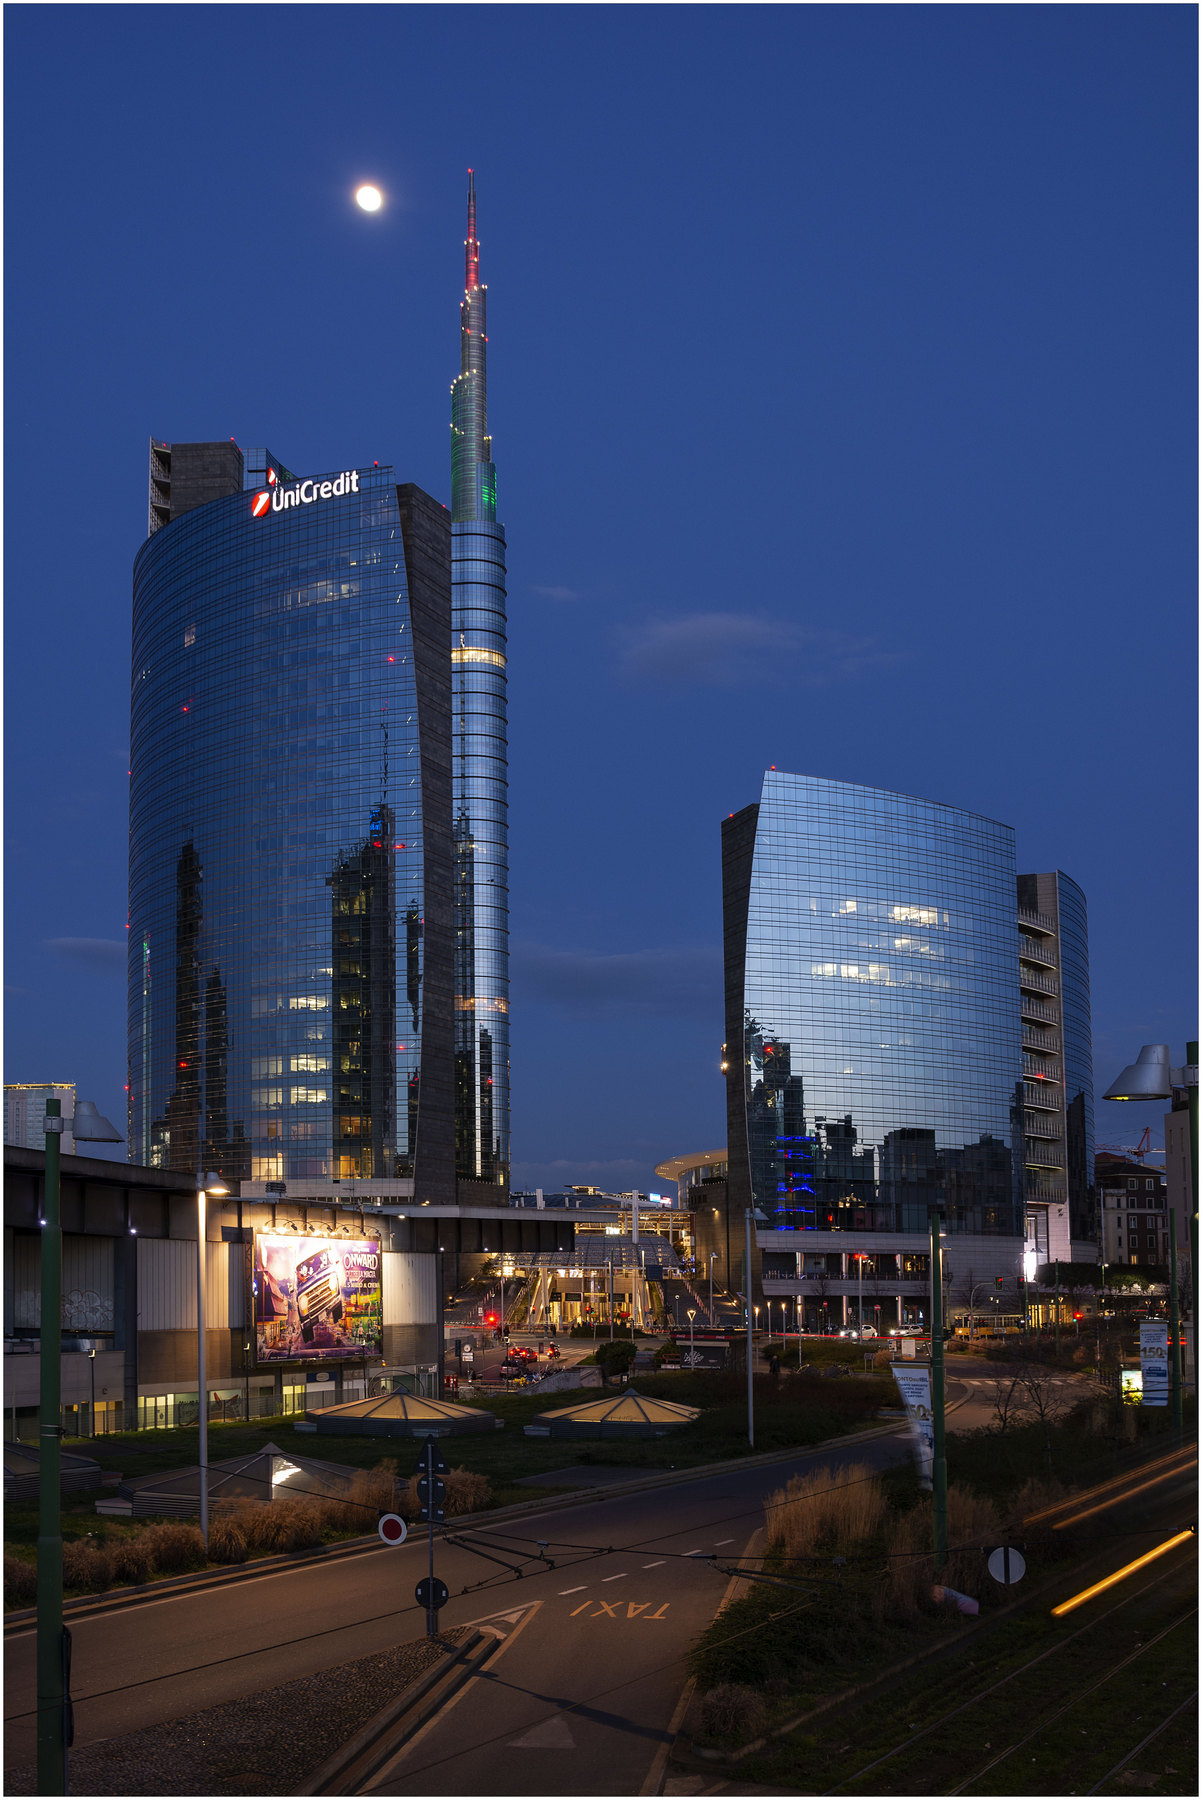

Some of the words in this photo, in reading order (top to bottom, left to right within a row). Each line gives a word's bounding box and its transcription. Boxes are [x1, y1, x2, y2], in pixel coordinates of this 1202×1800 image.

[272, 470, 359, 511] UniCredit
[343, 1254, 378, 1270] ONWARD
[569, 1600, 670, 1620] TAXI
